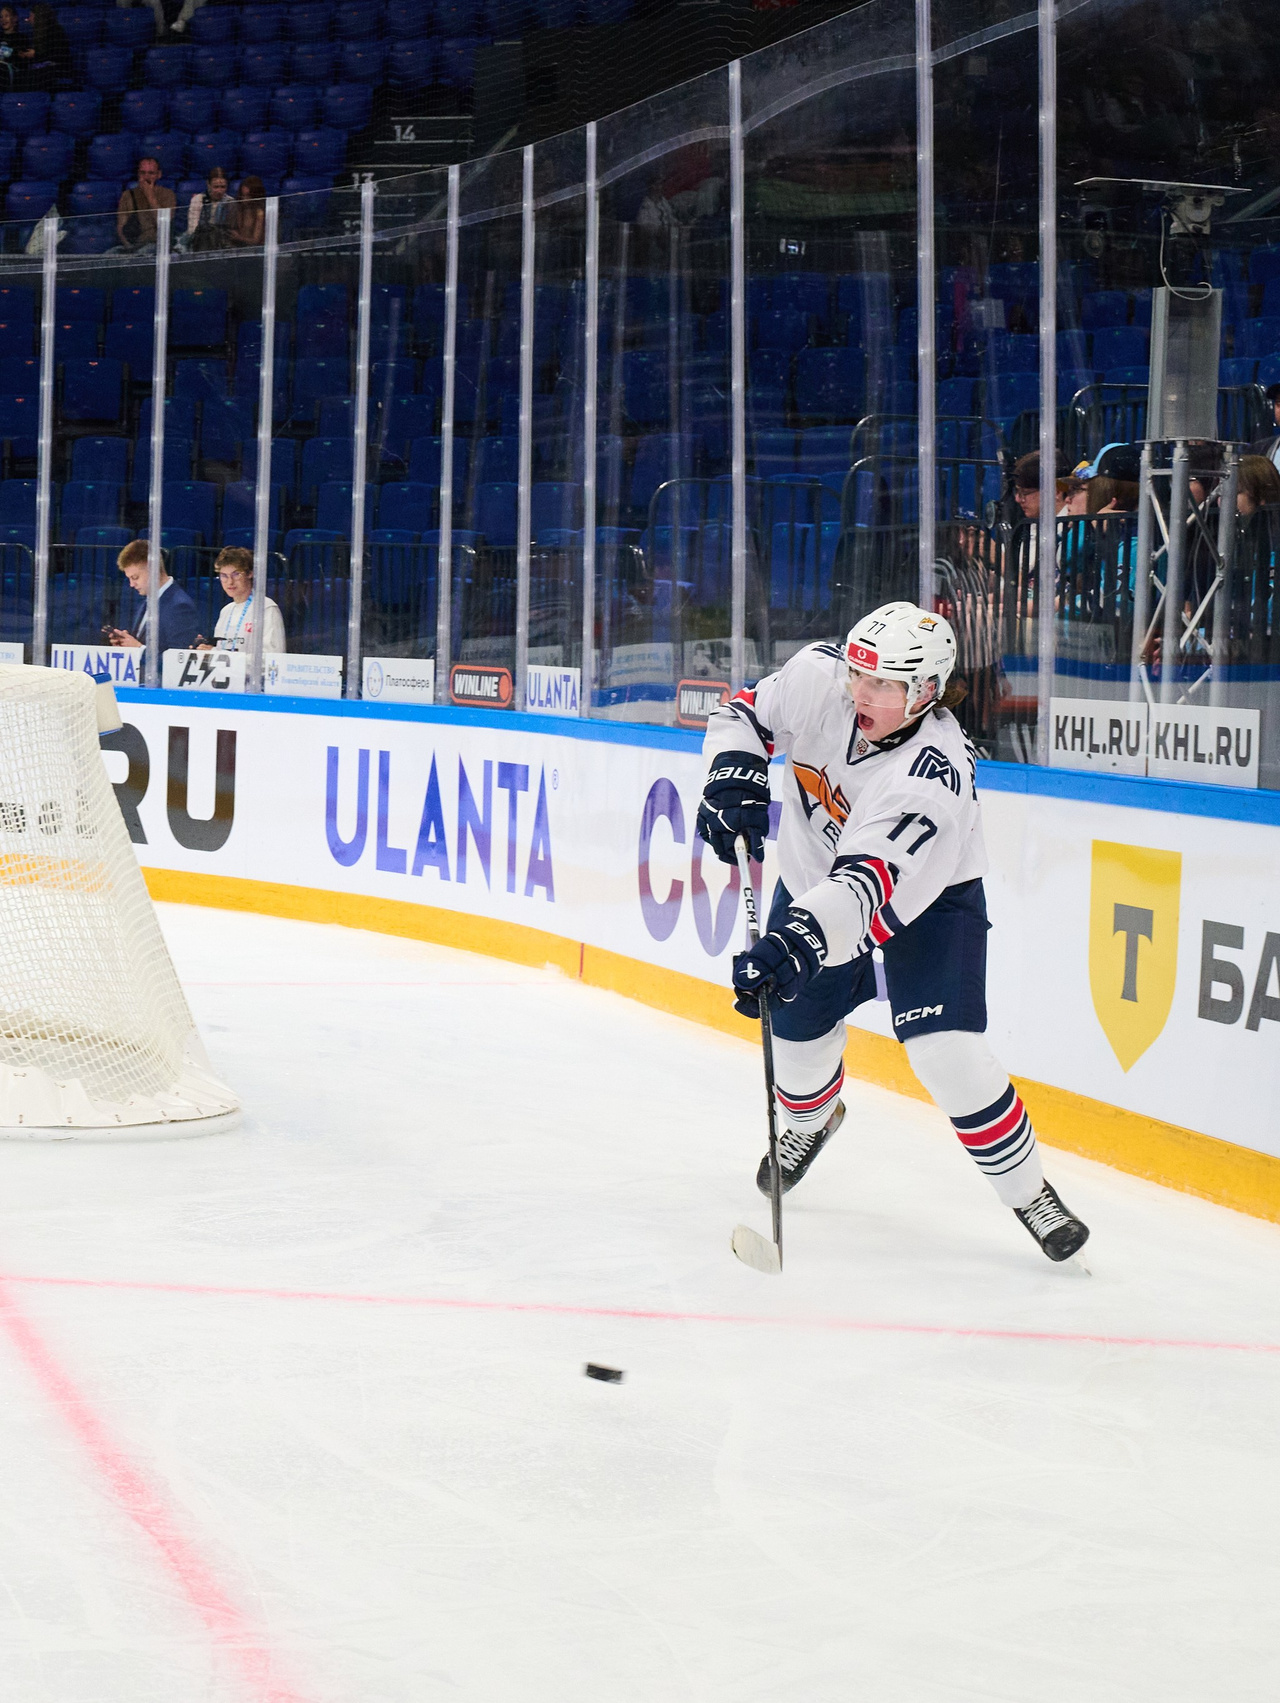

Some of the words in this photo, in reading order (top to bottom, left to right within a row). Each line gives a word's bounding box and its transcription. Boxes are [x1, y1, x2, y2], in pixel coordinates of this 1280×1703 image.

[394, 125, 416, 142] 14
[867, 620, 887, 635] 77
[385, 674, 430, 690] Платосфера
[454, 674, 498, 698] WINLINE
[529, 672, 578, 711] ULANTA
[1055, 715, 1141, 757] KHL.RU
[1155, 721, 1252, 767] KHL.RU
[886, 811, 938, 856] 77
[743, 886, 758, 930] CCM
[894, 1004, 944, 1027] CCM
